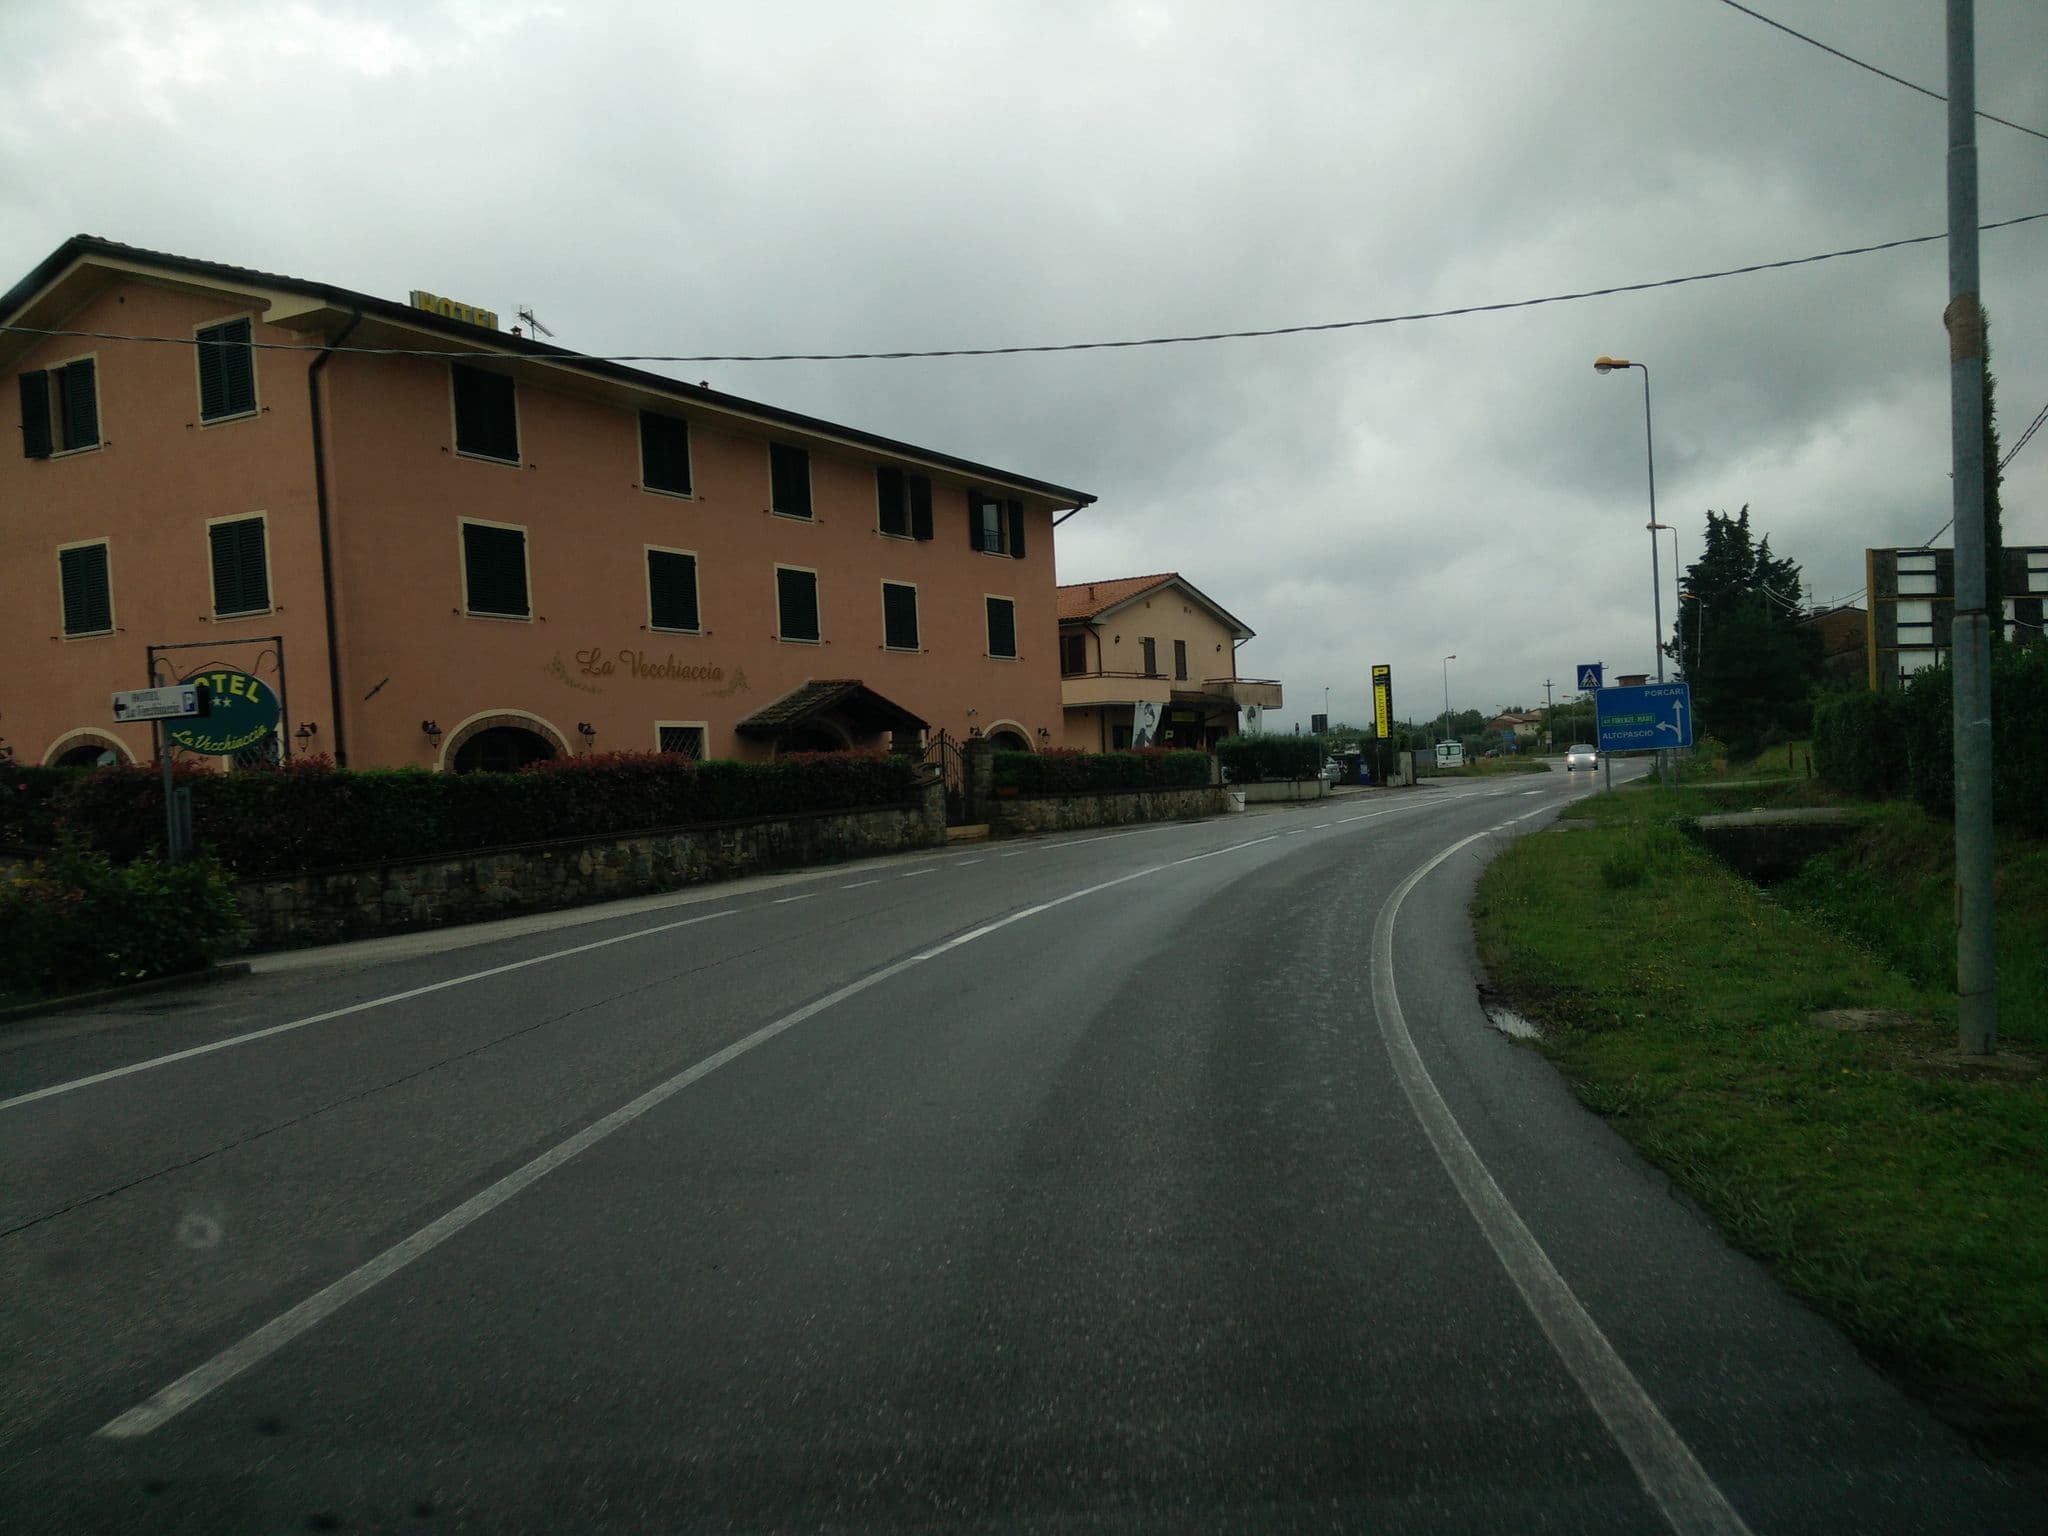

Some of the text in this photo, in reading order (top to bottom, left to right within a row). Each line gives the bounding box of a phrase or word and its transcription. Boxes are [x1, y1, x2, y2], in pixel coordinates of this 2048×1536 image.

[575, 647, 723, 681] La Vecchiaccia
[1644, 688, 1684, 697] PORCARI
[172, 729, 193, 746] La
[1602, 730, 1654, 739] ALTOPASCIO
